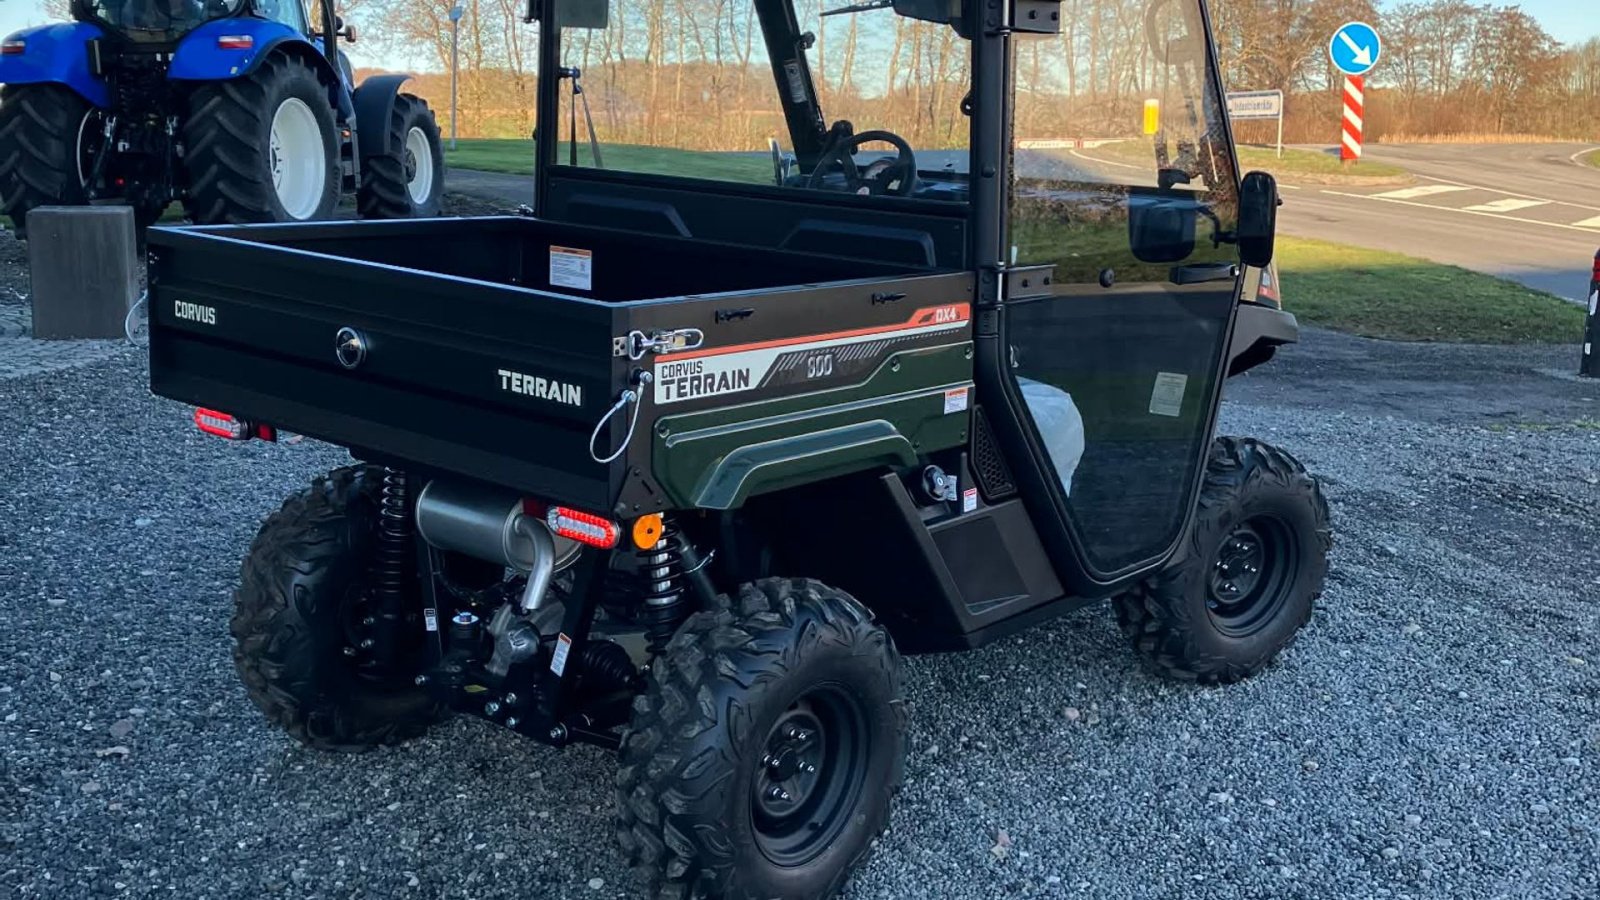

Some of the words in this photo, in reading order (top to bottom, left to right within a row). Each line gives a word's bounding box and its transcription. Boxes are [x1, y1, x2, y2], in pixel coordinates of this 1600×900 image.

[174, 299, 216, 325] CORVUS
[660, 368, 751, 400] TERRAIN
[661, 361, 703, 379] CORVUS
[498, 369, 582, 407] TERRAIN
